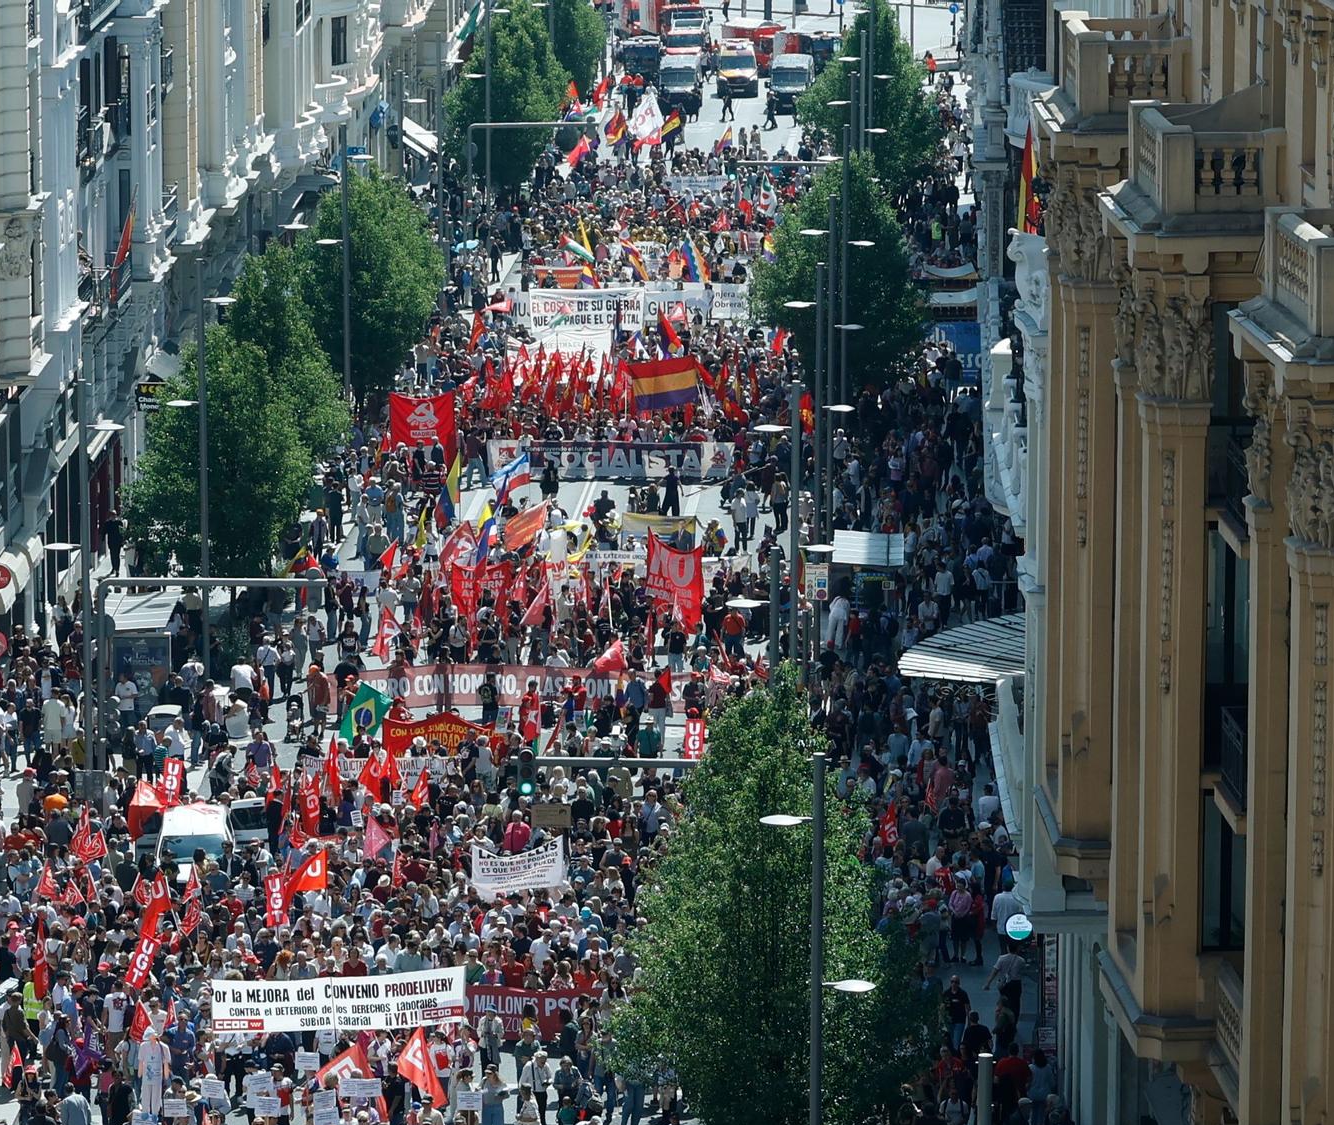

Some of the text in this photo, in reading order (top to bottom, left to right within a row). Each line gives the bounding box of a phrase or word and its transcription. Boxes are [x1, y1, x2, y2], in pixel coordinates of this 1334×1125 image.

[577, 300, 589, 311] DE
[592, 300, 604, 311] SU
[606, 315, 640, 327] CITAL
[544, 449, 701, 477] SOCIALISTA
[651, 550, 697, 586] NO
[411, 675, 445, 696] CON
[449, 675, 520, 698] HOMRO,
[688, 722, 701, 760] UGT
[268, 878, 284, 923] UGT
[131, 939, 155, 984] UGT
[232, 989, 242, 1003] la
[246, 988, 290, 1004] MEJORA
[297, 987, 315, 1001] del
[324, 983, 379, 1001] CONVENIO
[385, 977, 454, 999] PRODELIVERY
[229, 1007, 261, 1018] CONTRA
[275, 1006, 318, 1017] DETERIORO
[335, 1004, 348, 1015] los
[351, 1003, 391, 1015] DERECHOS
[423, 1008, 451, 1020] CCOO
[217, 1020, 249, 1031] CCOO
